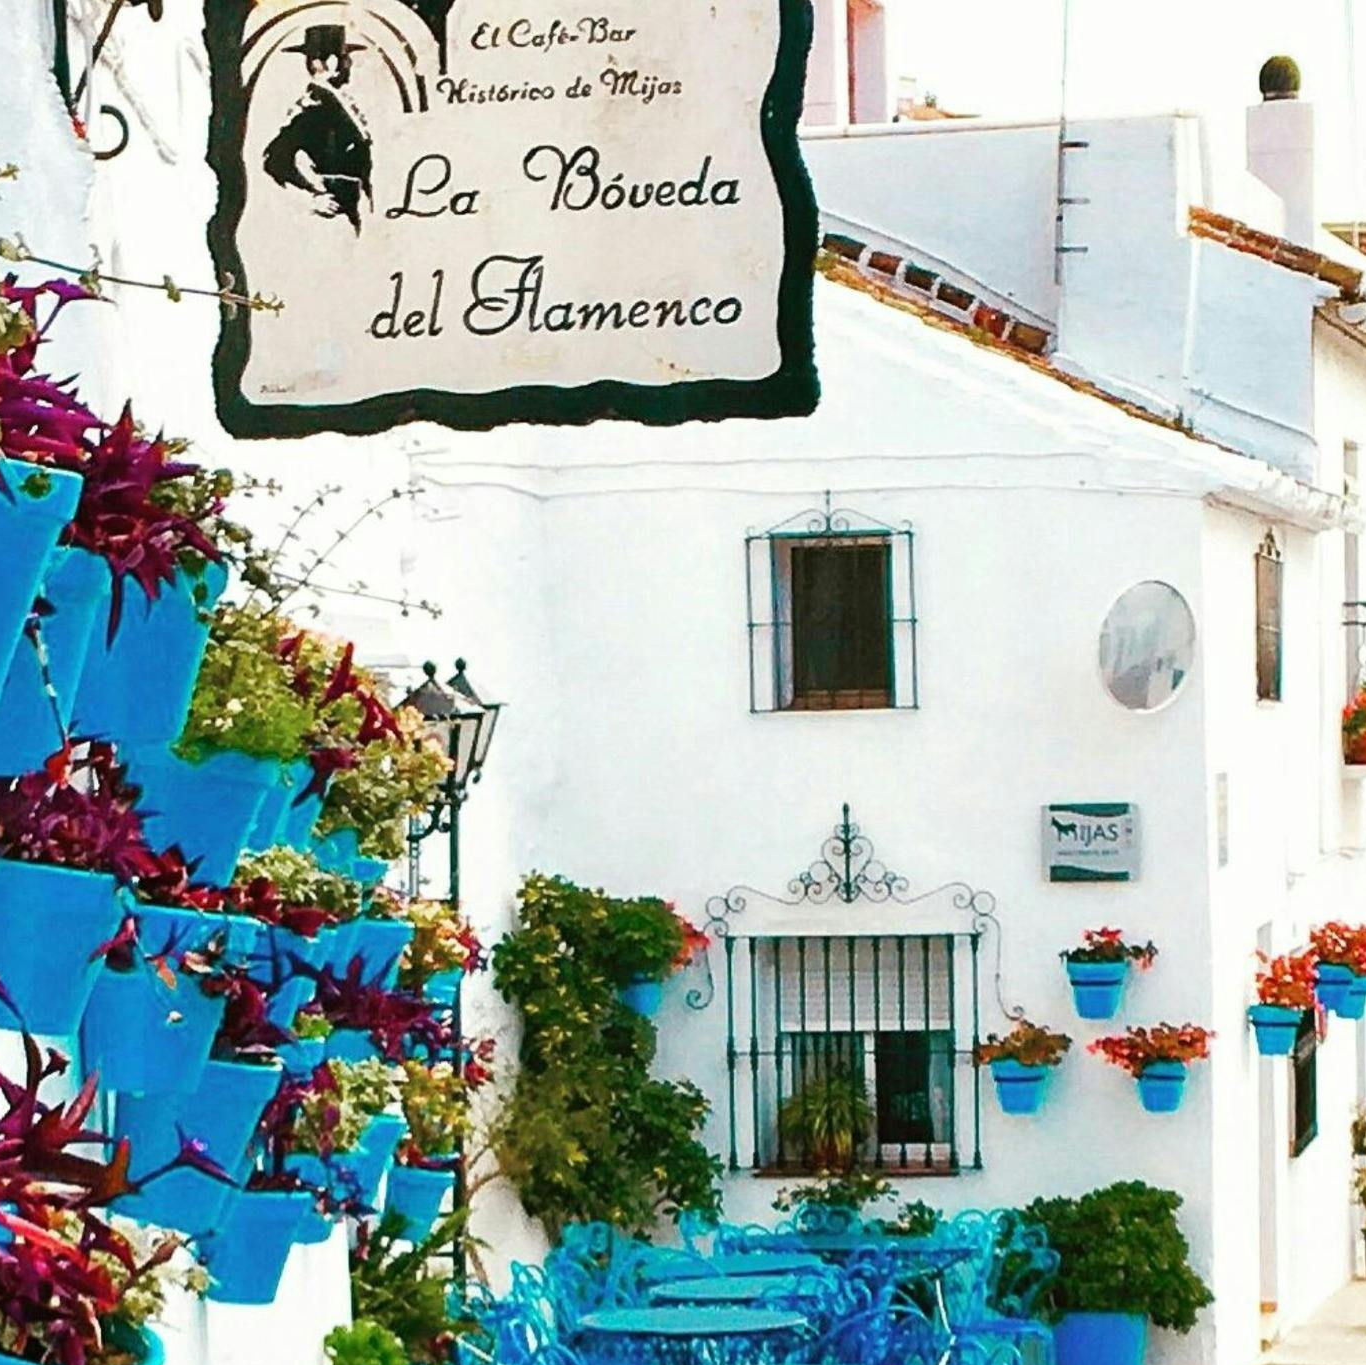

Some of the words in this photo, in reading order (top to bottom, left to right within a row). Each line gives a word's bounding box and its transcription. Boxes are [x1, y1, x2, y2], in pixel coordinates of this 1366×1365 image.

[471, 22, 500, 50] El
[507, 17, 636, 53] Café-Bar
[436, 78, 556, 104] Histórico
[565, 76, 592, 99] de
[600, 68, 683, 104] Mijas
[385, 154, 481, 220] La
[523, 145, 741, 212] Bóveda
[370, 270, 444, 340] del
[462, 254, 743, 336] Flamenco
